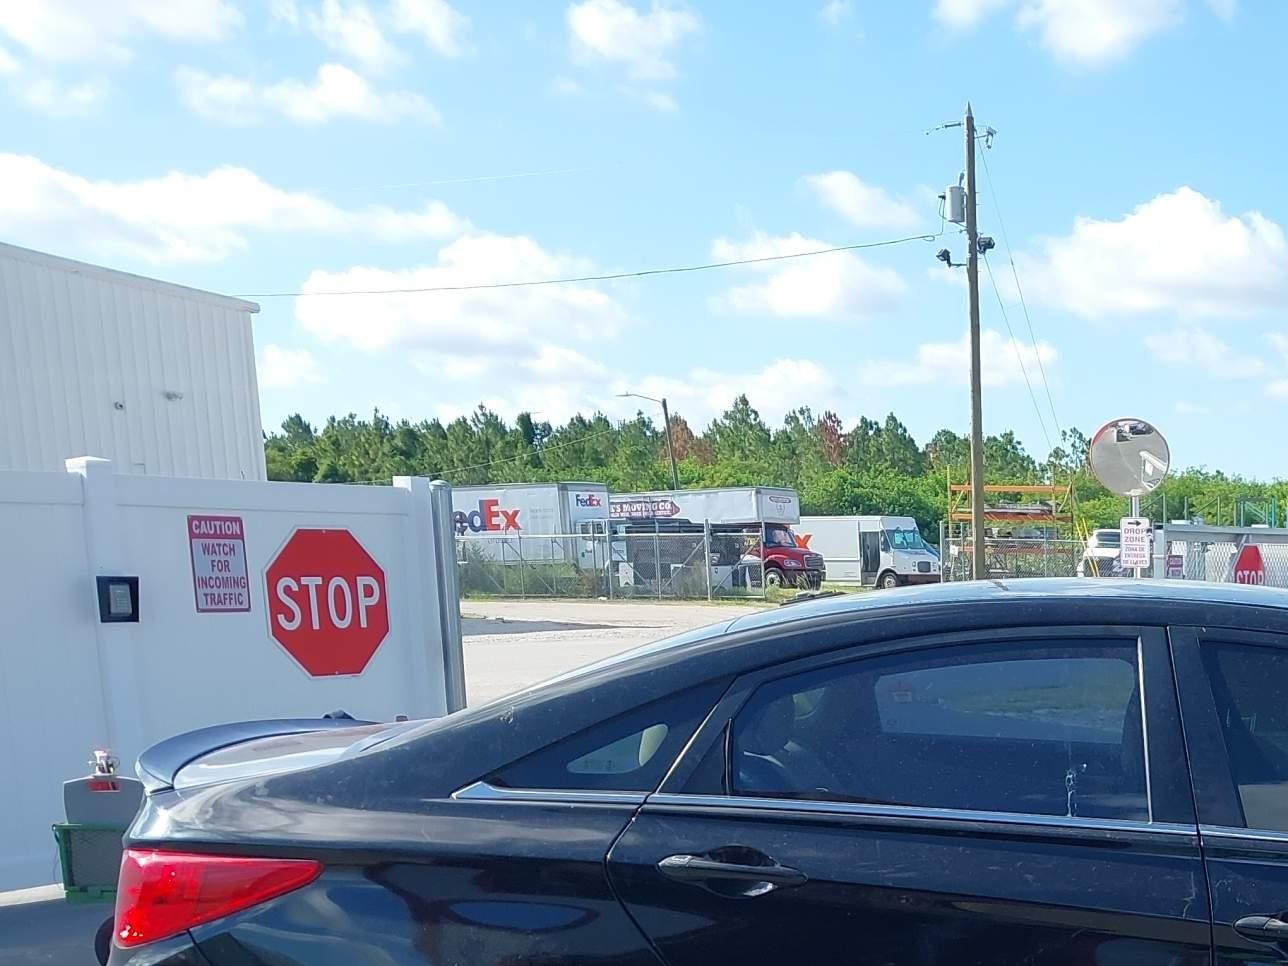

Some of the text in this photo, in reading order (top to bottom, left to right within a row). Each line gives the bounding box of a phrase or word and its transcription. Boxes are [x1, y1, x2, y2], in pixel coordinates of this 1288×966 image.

[576, 494, 601, 507] FedEx
[622, 502, 658, 513] MOVING
[453, 499, 521, 532] edEx
[192, 520, 240, 535] CAUTION
[1124, 527, 1146, 535] DROP
[201, 542, 236, 556] WATCH
[211, 559, 231, 573] FOR
[197, 575, 247, 590] INCOMING
[203, 592, 244, 606] TRAFFIC
[276, 576, 380, 631] STOP
